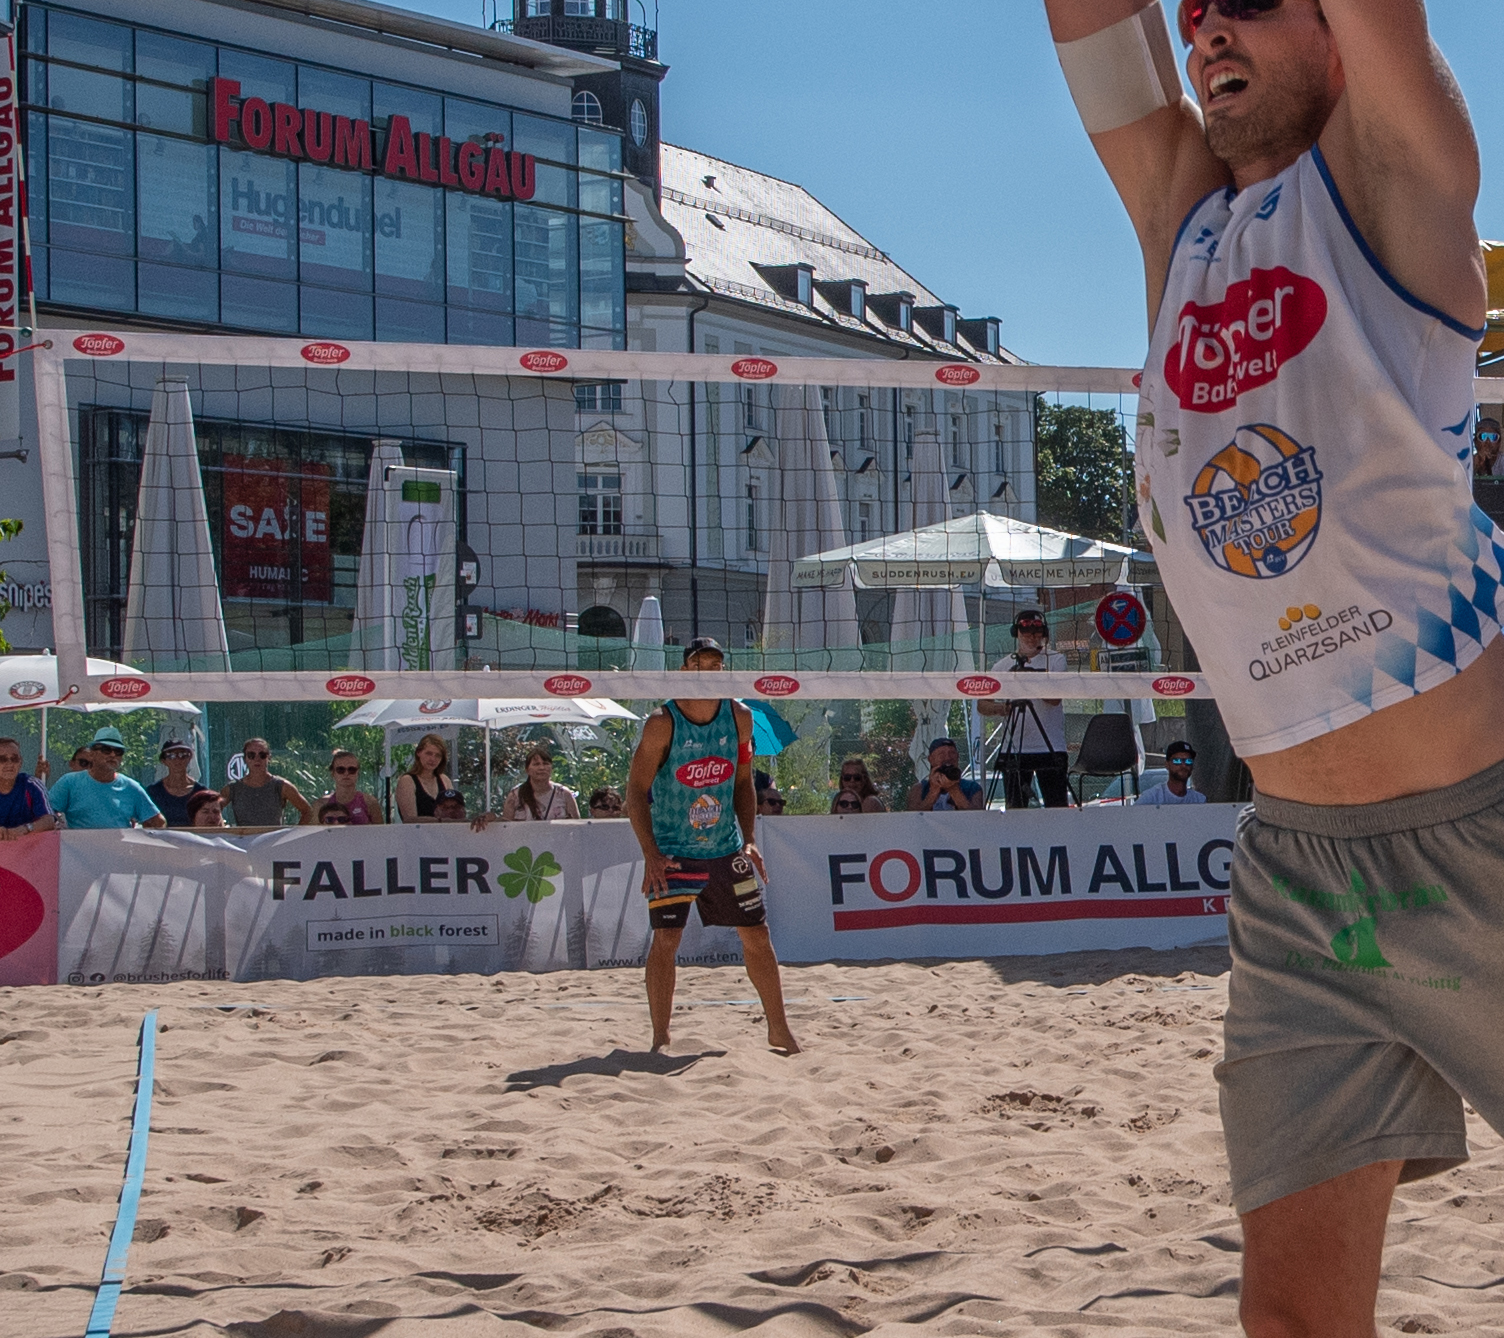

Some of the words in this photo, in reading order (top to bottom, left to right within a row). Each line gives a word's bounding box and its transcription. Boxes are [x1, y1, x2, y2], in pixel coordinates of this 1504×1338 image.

[214, 76, 373, 171] FORUM
[385, 114, 536, 200] ALLGÄU
[80, 335, 119, 352] Töpfer
[307, 344, 345, 360] Töpfer
[525, 352, 563, 368] Töpfer
[1186, 447, 1321, 529] BEACH
[1208, 485, 1318, 551] MASTERS
[1234, 518, 1295, 556] TOUR
[871, 569, 976, 580] SUDDENRUSH.EU
[1009, 568, 1042, 579] MAKE
[1046, 568, 1064, 578] ME
[1261, 605, 1363, 655] PLEINFELDER
[1249, 607, 1394, 682] QUARZSAND
[108, 679, 146, 695] Töpfer
[332, 676, 370, 692] Töpfer
[495, 704, 539, 714] ERDINGER
[271, 856, 492, 902] FALLER
[828, 844, 1073, 906] FORUM
[317, 925, 366, 943] made
[370, 925, 385, 940] in
[390, 922, 435, 938] black
[438, 922, 489, 938] forest
[112, 967, 231, 984] @brushesforlife
